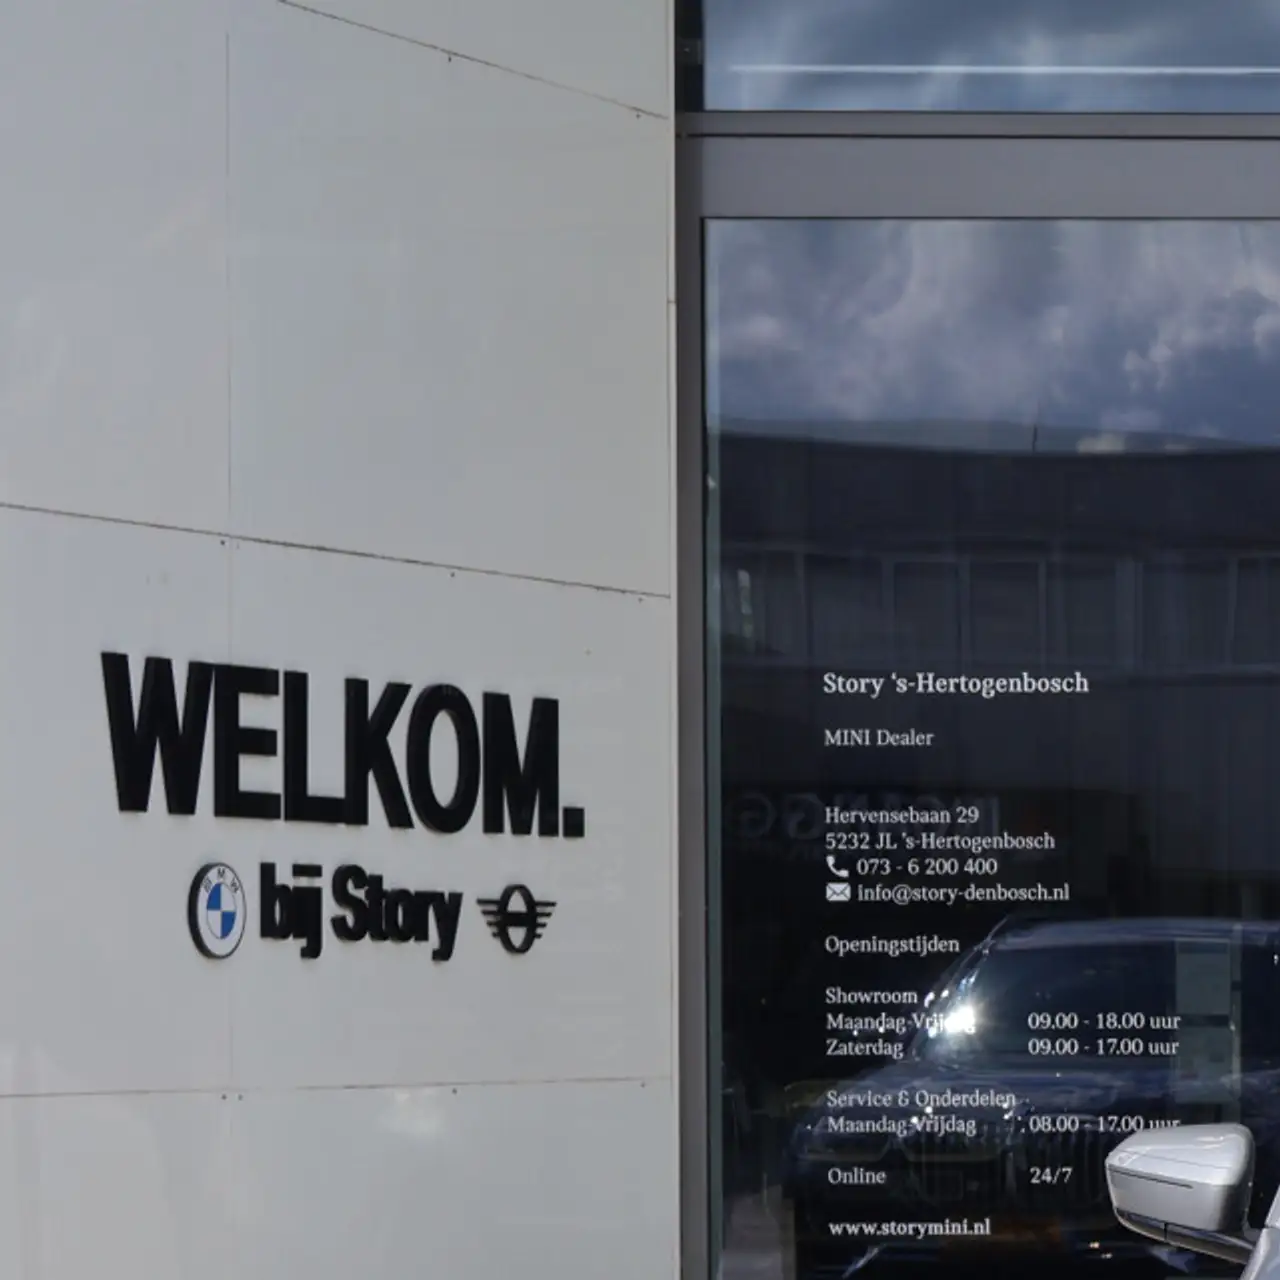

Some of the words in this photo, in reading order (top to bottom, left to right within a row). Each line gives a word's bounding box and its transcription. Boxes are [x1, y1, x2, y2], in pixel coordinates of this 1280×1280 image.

[823, 673, 885, 699] Story
[100, 651, 585, 838] WELKOM.
[825, 729, 870, 746] MINI
[877, 729, 934, 746] Dealer
[825, 806, 951, 824] Hervensebaan
[956, 806, 980, 824] 29
[826, 832, 870, 850] 5232
[875, 832, 898, 850] JL
[856, 858, 891, 875] 073
[907, 858, 920, 875] 6
[925, 858, 959, 875] 200
[963, 858, 998, 875] 400
[858, 883, 1070, 905] info@story-denbosch.nl
[259, 862, 323, 958] bij
[330, 863, 463, 961] Story
[825, 935, 960, 957] Openingstijden
[825, 987, 918, 1004] Showroom
[1027, 1013, 1079, 1029] 09.00
[1097, 1012, 1145, 1029] 18.00
[1150, 1016, 1181, 1029] uur
[826, 1038, 904, 1060] Zaterdag
[1028, 1038, 1079, 1055] 09.00
[1097, 1038, 1144, 1055] 17.00
[1148, 1041, 1180, 1055] uur
[827, 1090, 893, 1108] Service
[897, 1089, 910, 1107] &
[915, 1089, 1017, 1109] Onderdelen
[828, 1114, 977, 1138] Maandag-Vrijdag
[1029, 1115, 1080, 1132] 08.00
[1098, 1115, 1144, 1132] 17.00
[827, 1167, 886, 1184] Online
[1030, 1167, 1073, 1184] 24/7
[829, 1217, 991, 1240] www.storymini.nl
